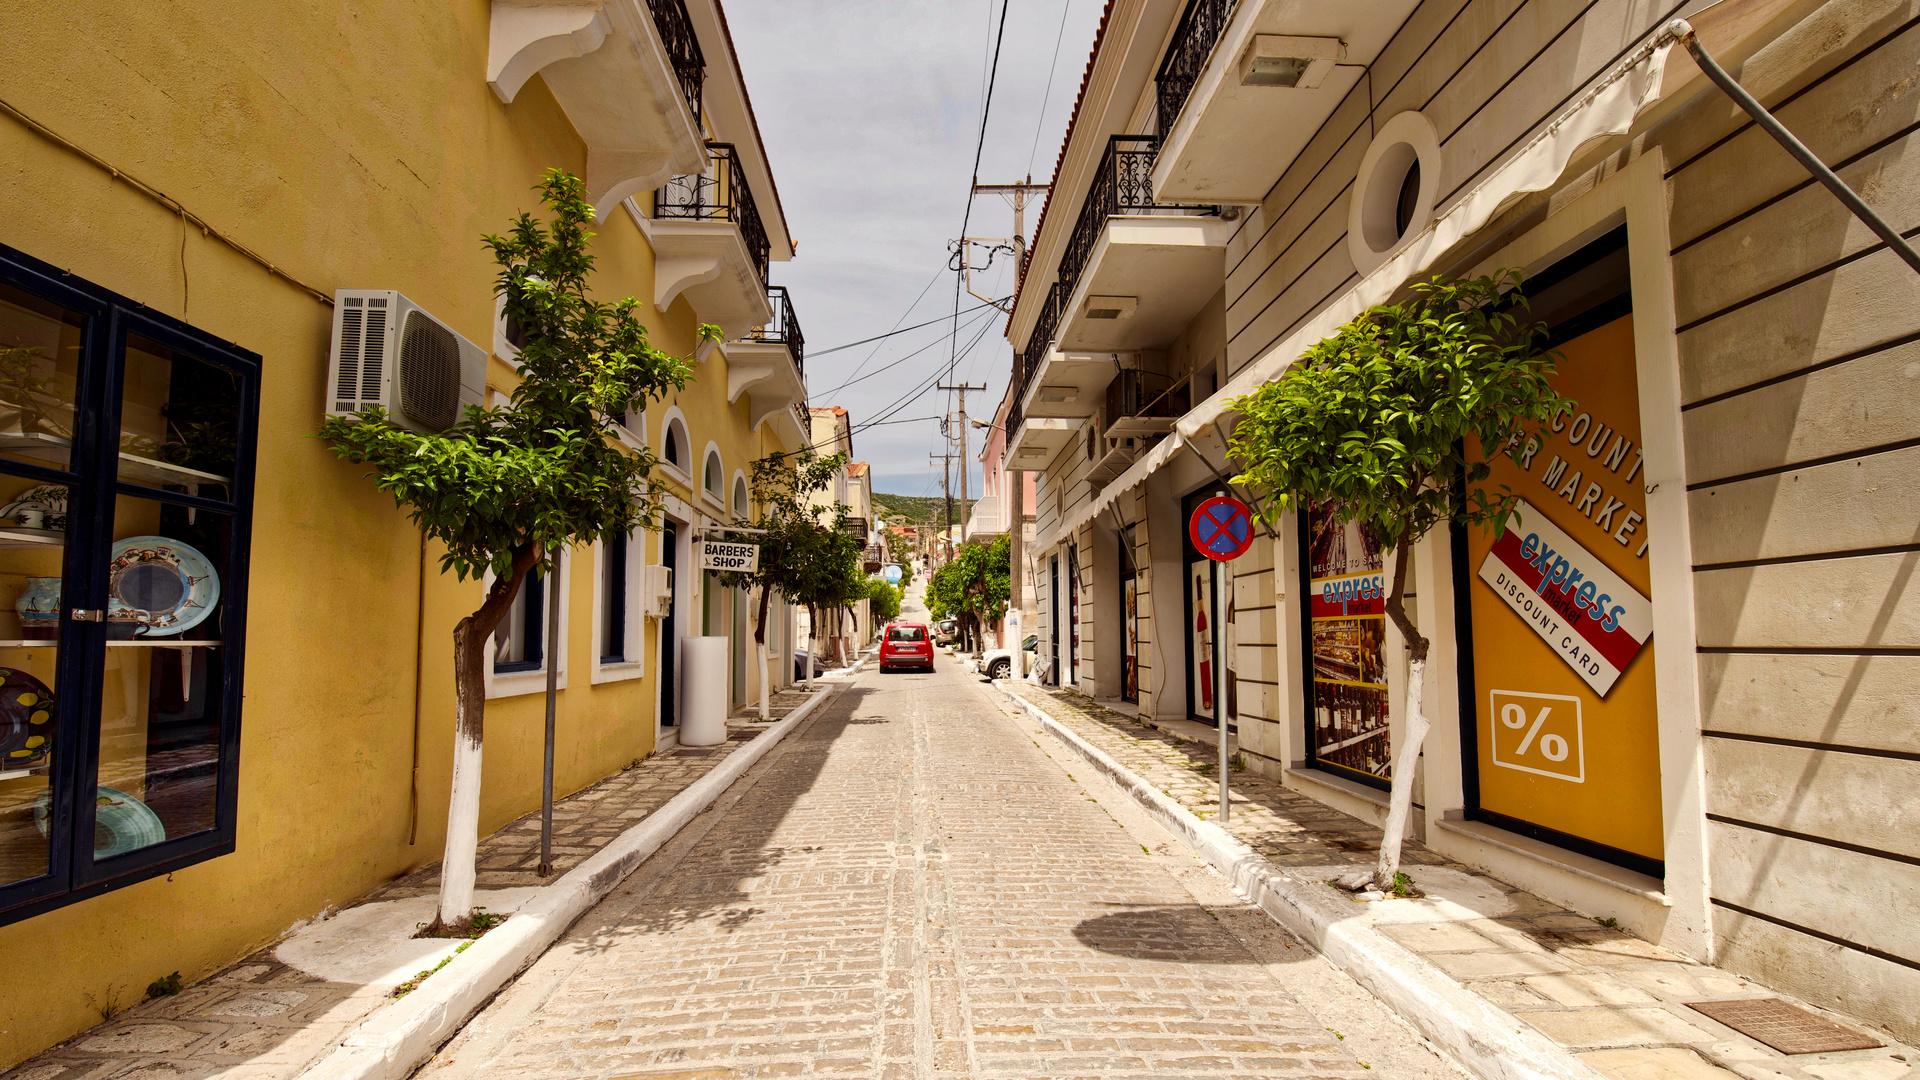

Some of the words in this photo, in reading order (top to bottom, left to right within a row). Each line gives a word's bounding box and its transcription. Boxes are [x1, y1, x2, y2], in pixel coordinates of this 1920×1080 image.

[704, 544, 754, 558] BARBERS
[712, 556, 745, 568] SHOP
[1312, 559, 1346, 573] WELCOME
[1349, 557, 1360, 568] TO
[1520, 532, 1626, 632] express
[1348, 600, 1372, 614] market
[1543, 587, 1582, 626] market
[1496, 572, 1559, 635] DISCOUNT
[1561, 636, 1600, 677] CARD
